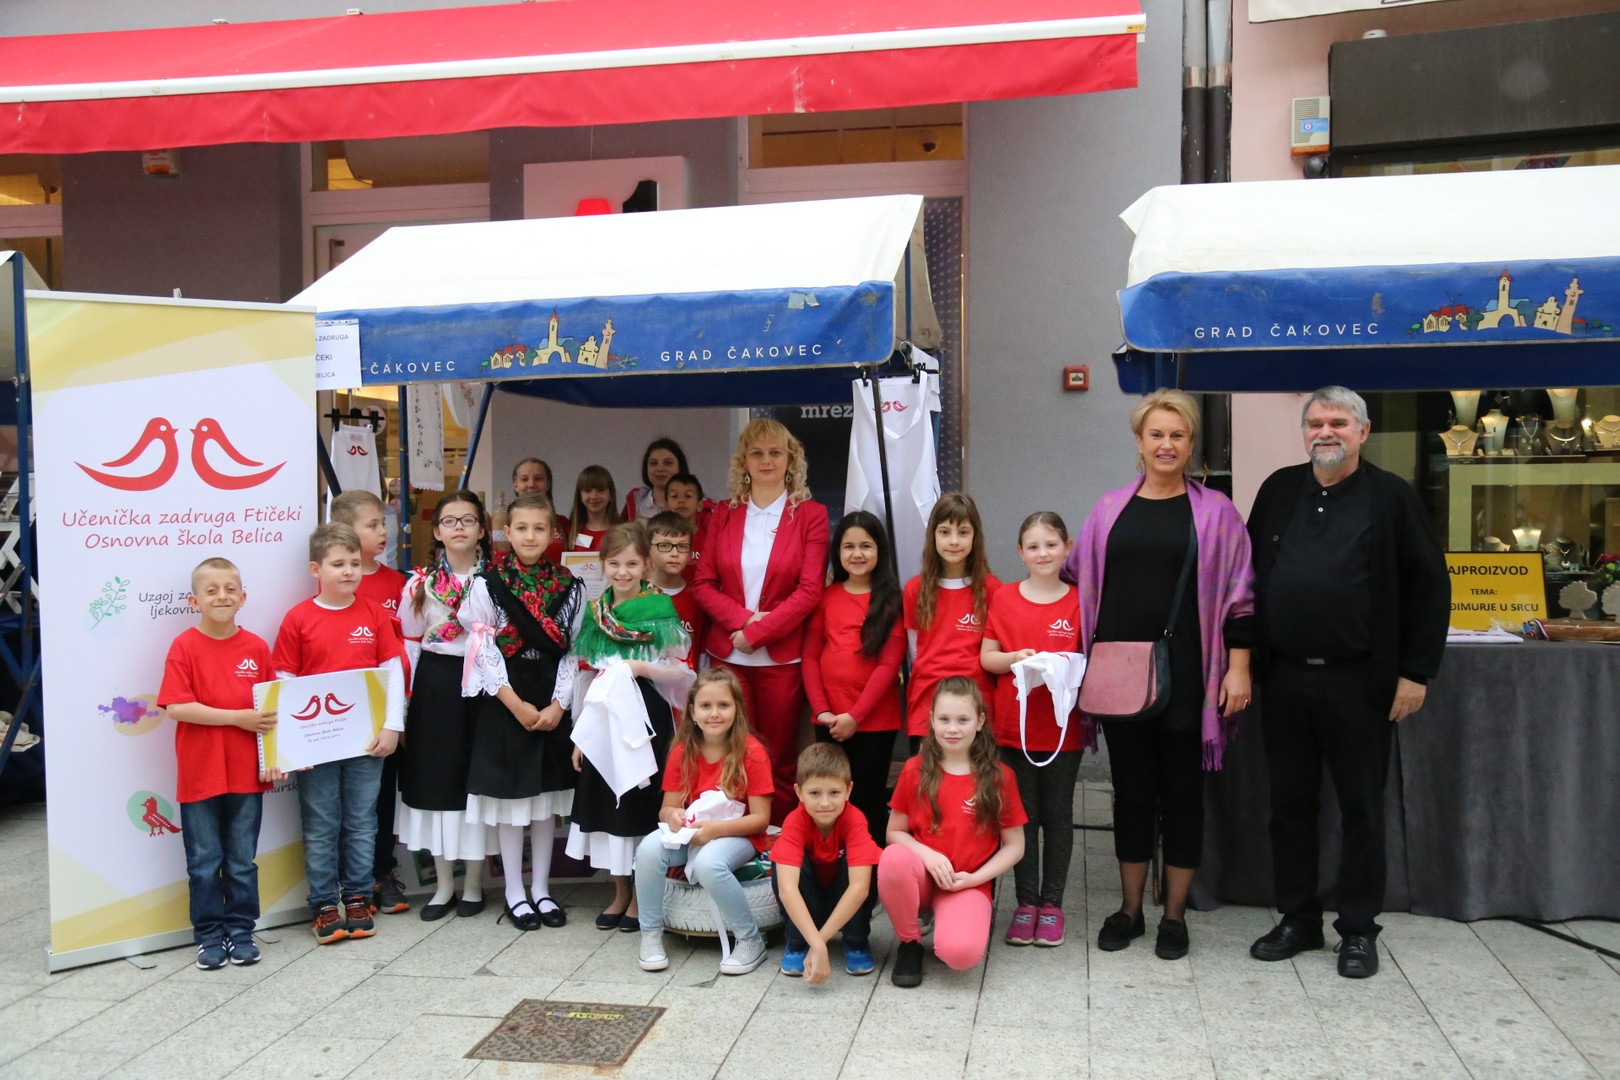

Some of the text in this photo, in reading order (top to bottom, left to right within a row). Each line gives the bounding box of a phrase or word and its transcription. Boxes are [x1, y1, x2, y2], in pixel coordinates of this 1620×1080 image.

[1194, 322, 1379, 339] GRAD ČAKOVEC
[318, 334, 349, 342] ZADRUGA
[315, 352, 333, 361] ČEKI
[660, 344, 822, 362] GRAD ČAKOVEC
[370, 360, 456, 375] ČAKOVEC
[800, 405, 854, 419] mrez
[62, 506, 303, 528] Učenička zadruga Ftičeki
[84, 527, 283, 549] Osnovna škola Belica
[1448, 565, 1529, 576] AJPROIZVOD
[138, 589, 174, 605] Uzgoj
[1470, 588, 1498, 596] TEMA:
[1499, 603, 1508, 611] U
[1510, 603, 1539, 612] SRCU
